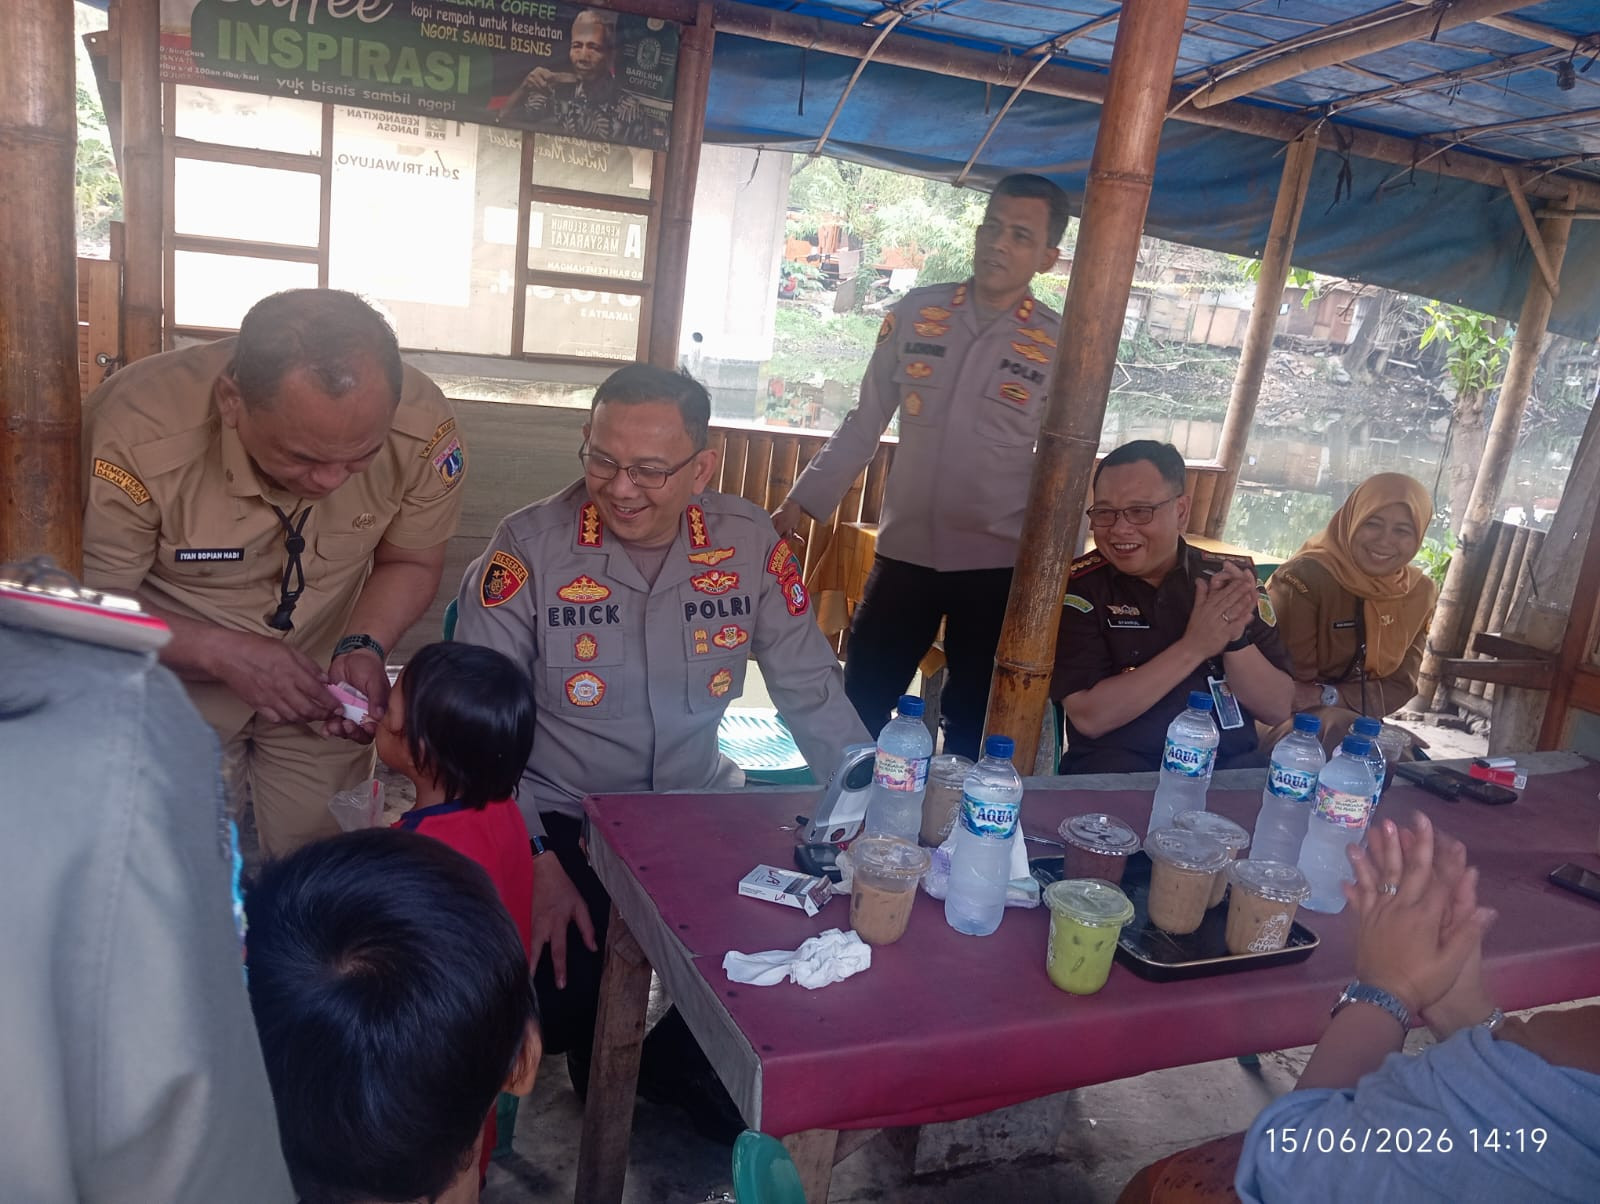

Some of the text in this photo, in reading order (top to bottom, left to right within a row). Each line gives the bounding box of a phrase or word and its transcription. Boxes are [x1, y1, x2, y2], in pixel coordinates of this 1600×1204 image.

[411, 3, 563, 40] kopi rempah untuk kesehatan
[501, 0, 557, 20] COFFEE
[420, 23, 552, 56] NGOPI SAMBIL BISNIS
[217, 18, 470, 95] INSPIRASI
[276, 78, 457, 113] yuk bisnis sambil ngopi
[96, 469, 123, 485] DALAM
[99, 461, 148, 499] KEMENTERIAN
[495, 553, 526, 580] RESERSE
[548, 594, 751, 628] ERICK POLRI
[1166, 747, 1200, 764] AQUA
[1275, 770, 1309, 790] AQUA
[976, 807, 1013, 826] AQUA
